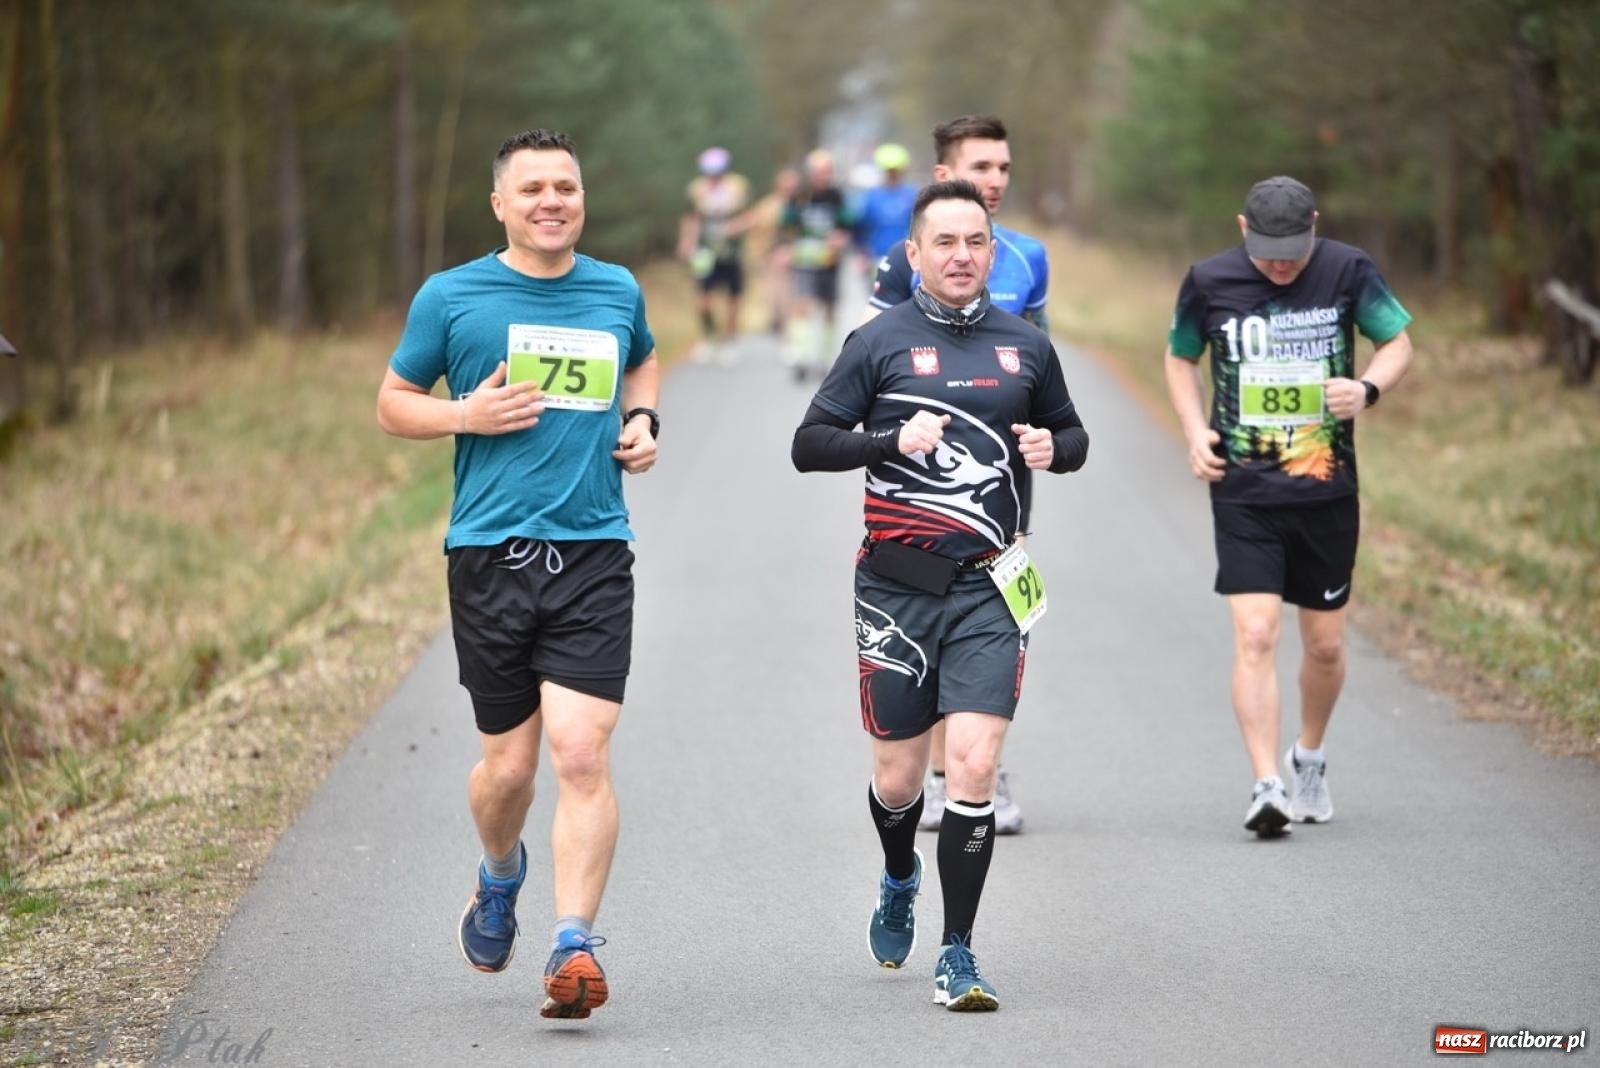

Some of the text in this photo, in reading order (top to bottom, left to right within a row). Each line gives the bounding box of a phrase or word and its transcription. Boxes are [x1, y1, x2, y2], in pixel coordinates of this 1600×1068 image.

[1221, 315, 1267, 362] 10
[540, 356, 587, 394] 75
[1262, 387, 1302, 413] 83
[1018, 566, 1042, 609] 92
